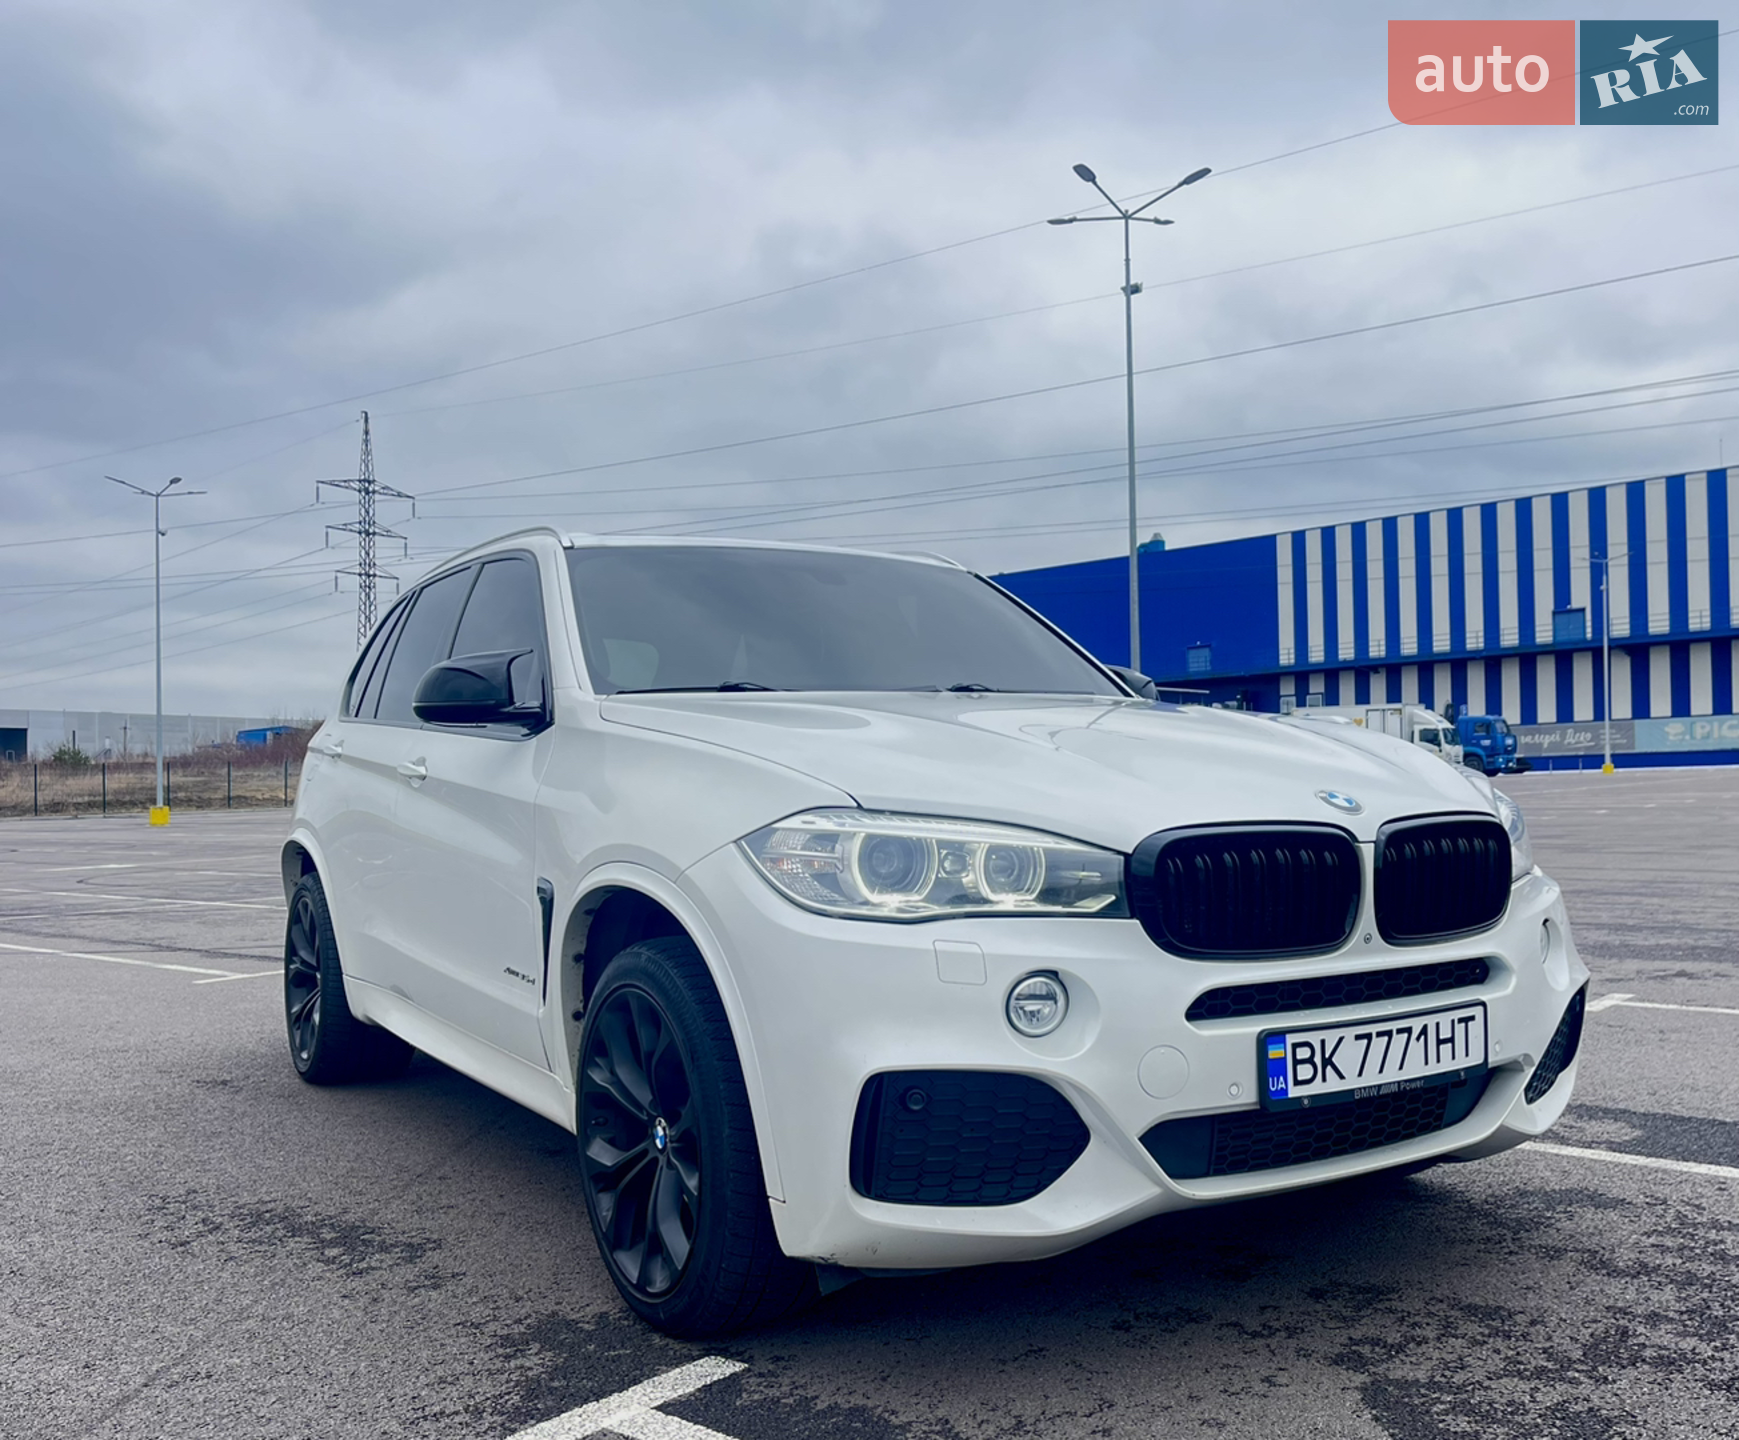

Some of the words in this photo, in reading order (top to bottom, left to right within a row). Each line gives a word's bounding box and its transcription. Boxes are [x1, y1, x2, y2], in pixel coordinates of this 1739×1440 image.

[1291, 1036, 1346, 1087] BK
[1269, 1076, 1286, 1091] UA
[1354, 1086, 1378, 1099] BMW
